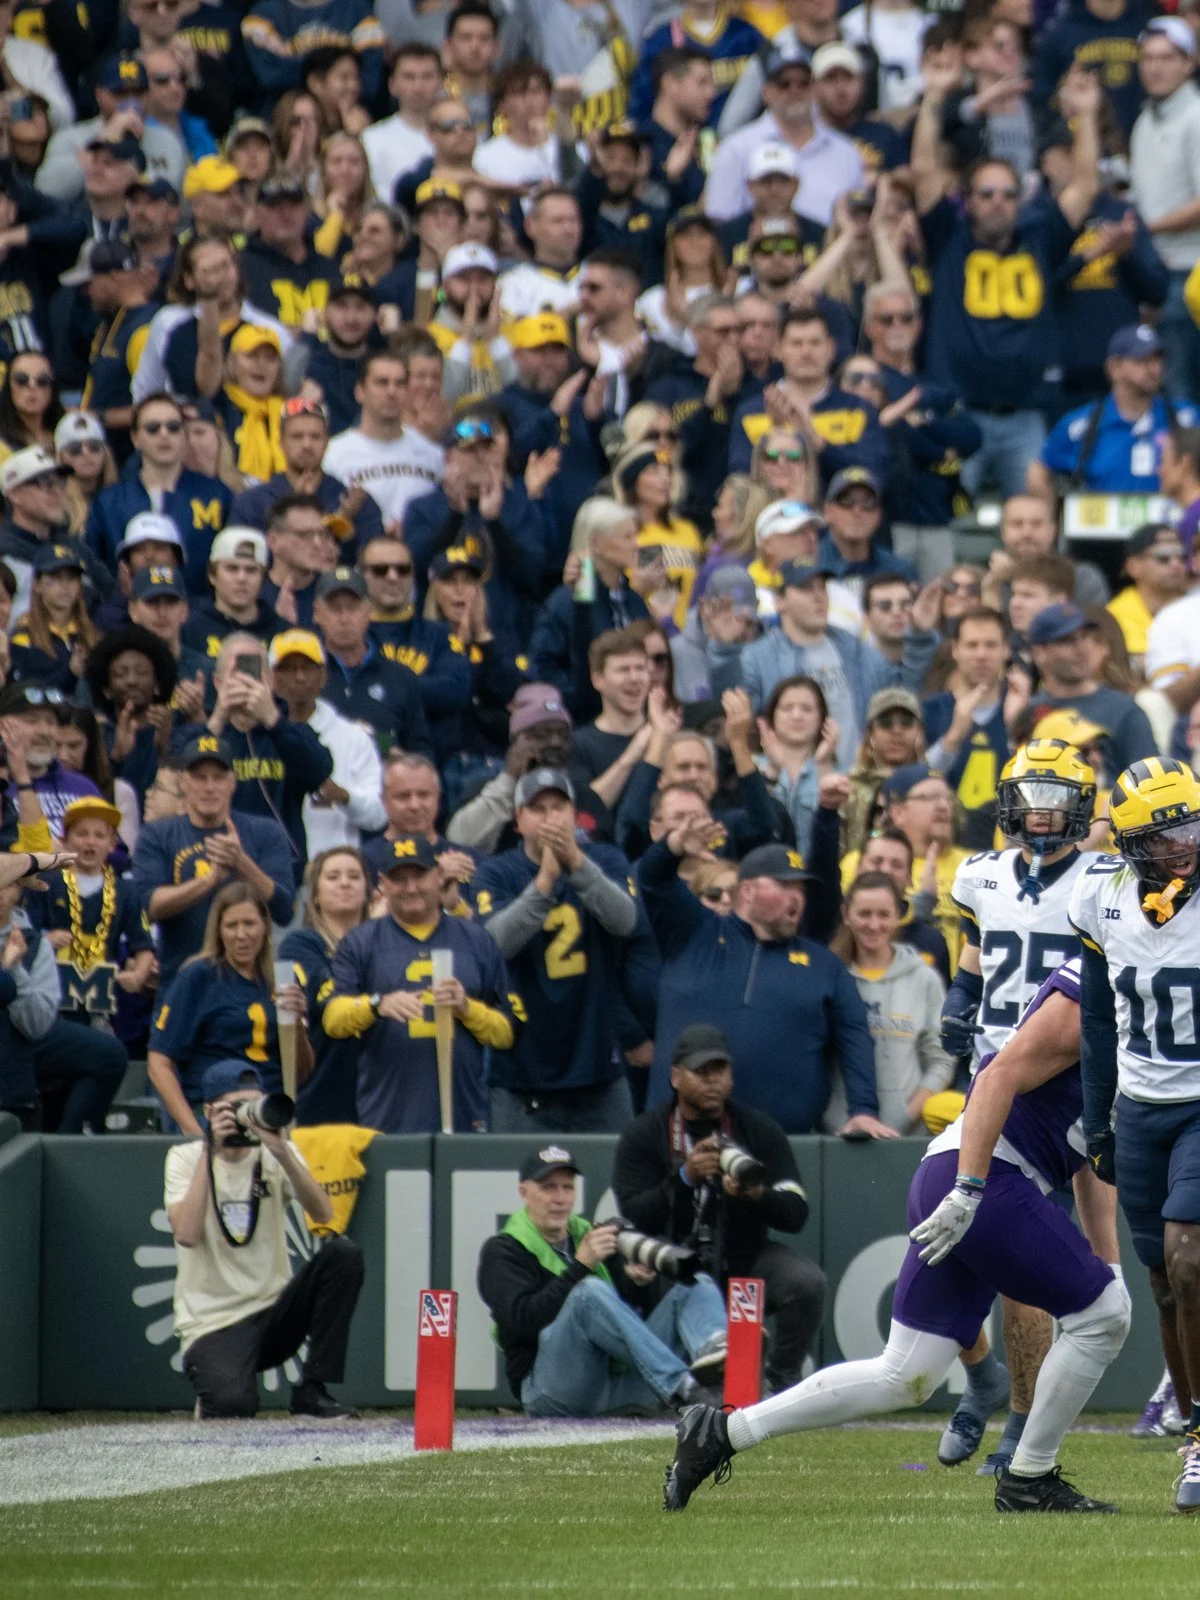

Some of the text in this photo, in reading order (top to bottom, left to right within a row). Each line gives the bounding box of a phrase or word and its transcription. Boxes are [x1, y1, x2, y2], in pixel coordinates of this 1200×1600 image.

[270, 279, 329, 341] M
[962, 250, 1044, 320] 00
[347, 464, 438, 486] MICHIGAN
[191, 499, 222, 531] M
[543, 903, 587, 979] 2
[56, 961, 118, 1012] M
[245, 1002, 269, 1062] 1
